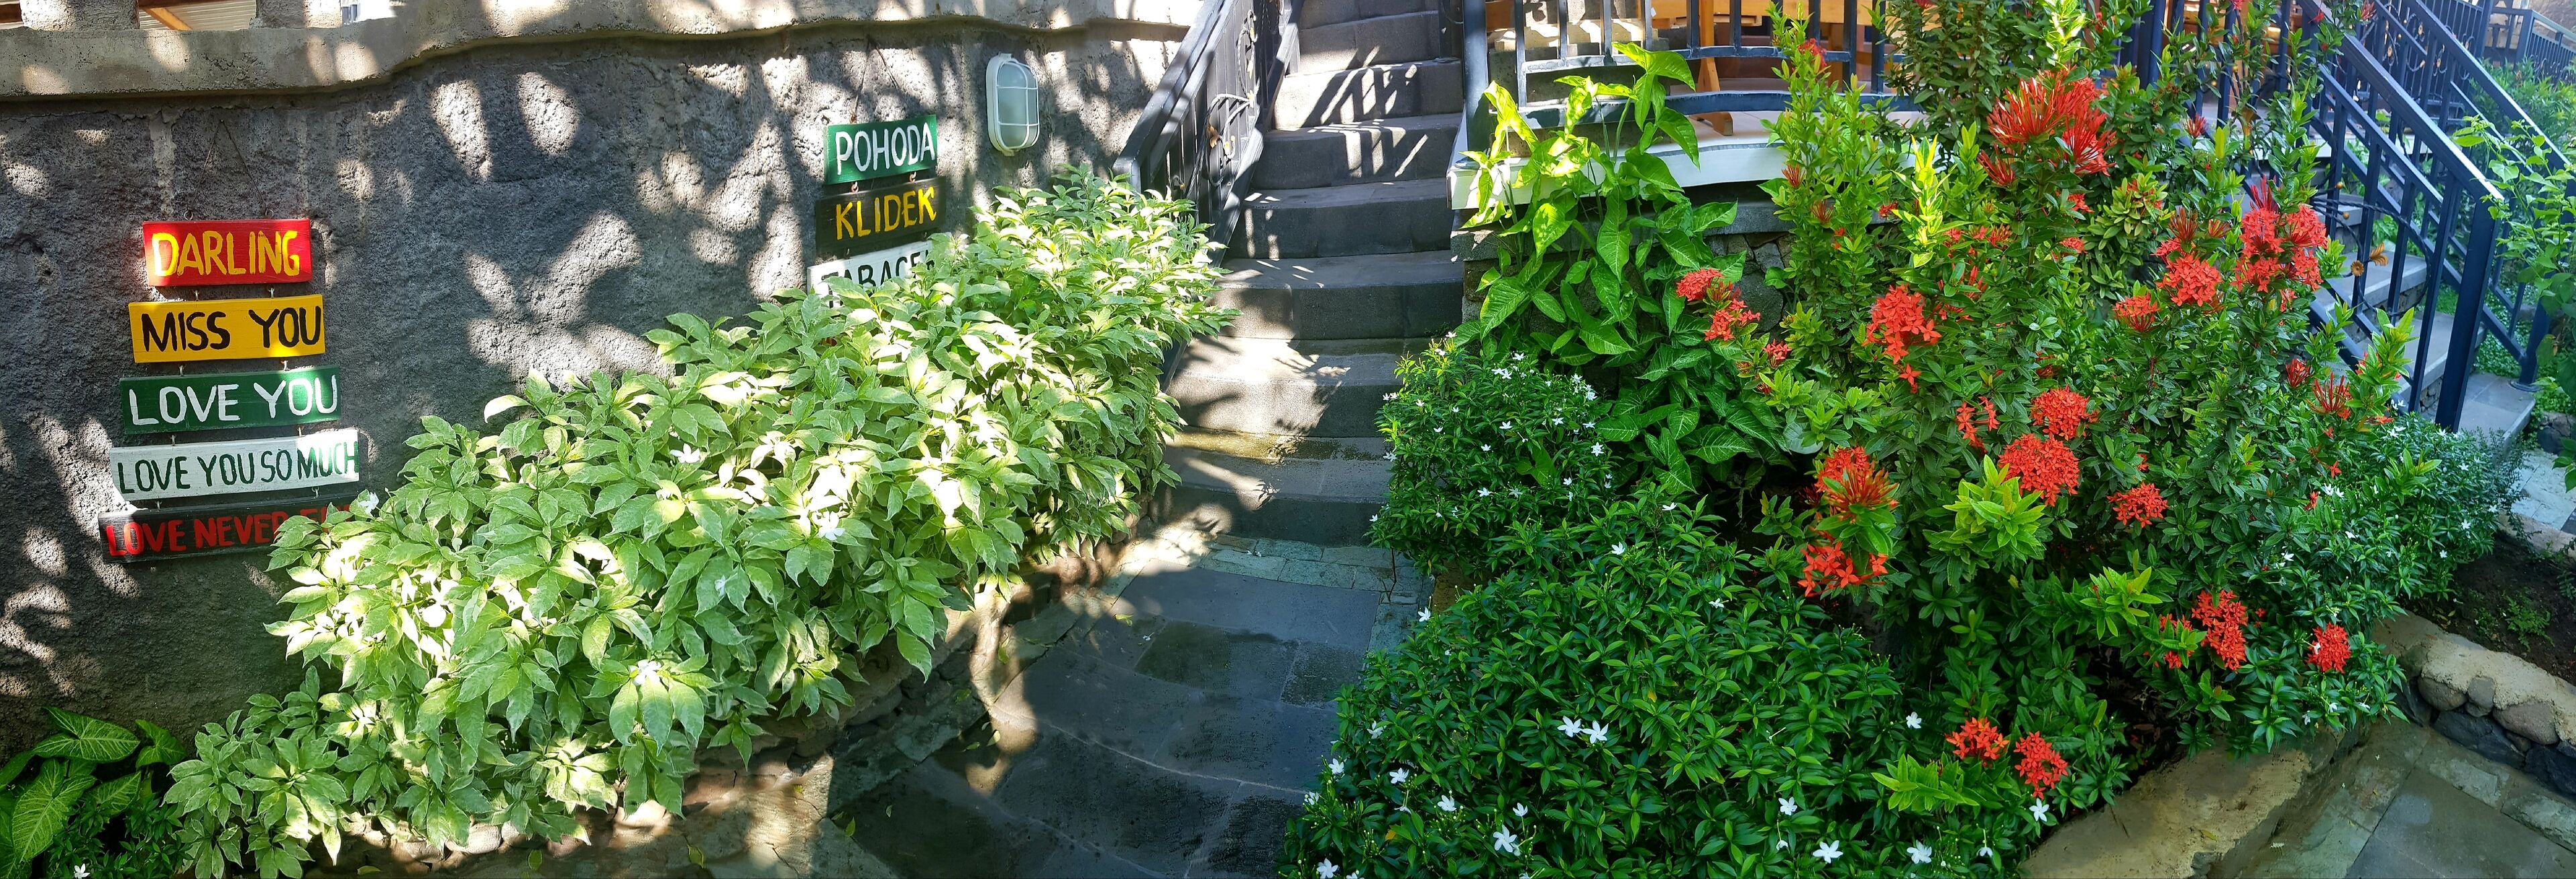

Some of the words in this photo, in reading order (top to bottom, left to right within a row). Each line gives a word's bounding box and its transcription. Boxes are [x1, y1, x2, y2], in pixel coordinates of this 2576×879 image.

[835, 123, 936, 175] POHODA
[836, 186, 937, 240] KLIDEK
[152, 230, 300, 276] DARLING
[142, 311, 231, 352] MISS
[249, 306, 322, 348] YOU
[129, 384, 240, 425] LOVE
[254, 374, 337, 418] YOU
[118, 456, 191, 494] LOVE
[197, 453, 255, 487] YOU
[261, 447, 292, 482] SO
[297, 441, 358, 479] MUCH
[105, 520, 186, 557] LOVE
